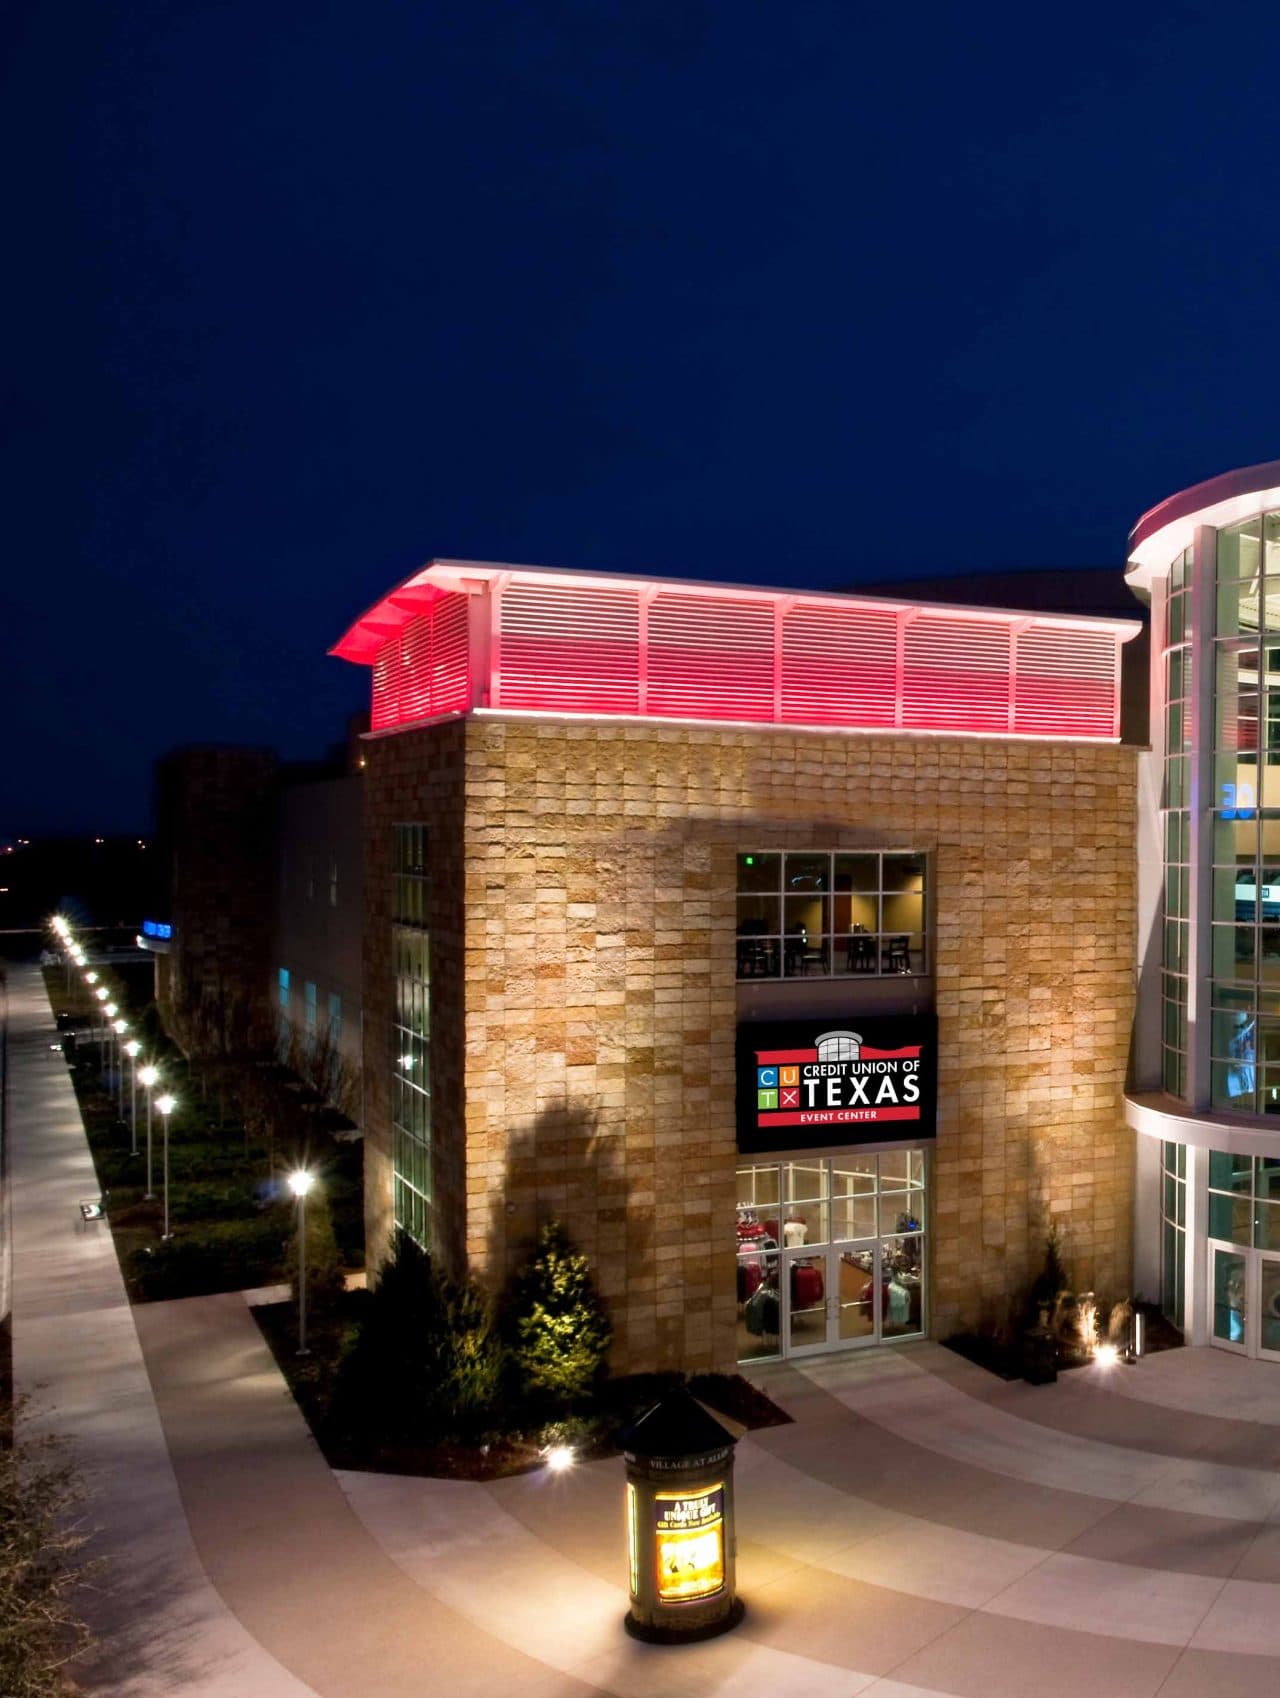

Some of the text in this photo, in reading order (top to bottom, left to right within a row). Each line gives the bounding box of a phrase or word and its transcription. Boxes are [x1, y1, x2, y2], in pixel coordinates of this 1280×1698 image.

[803, 1060, 920, 1077] CREDIT UNION OF
[803, 1074, 920, 1108] TEXAS
[800, 1110, 877, 1122] EVENT CENTER
